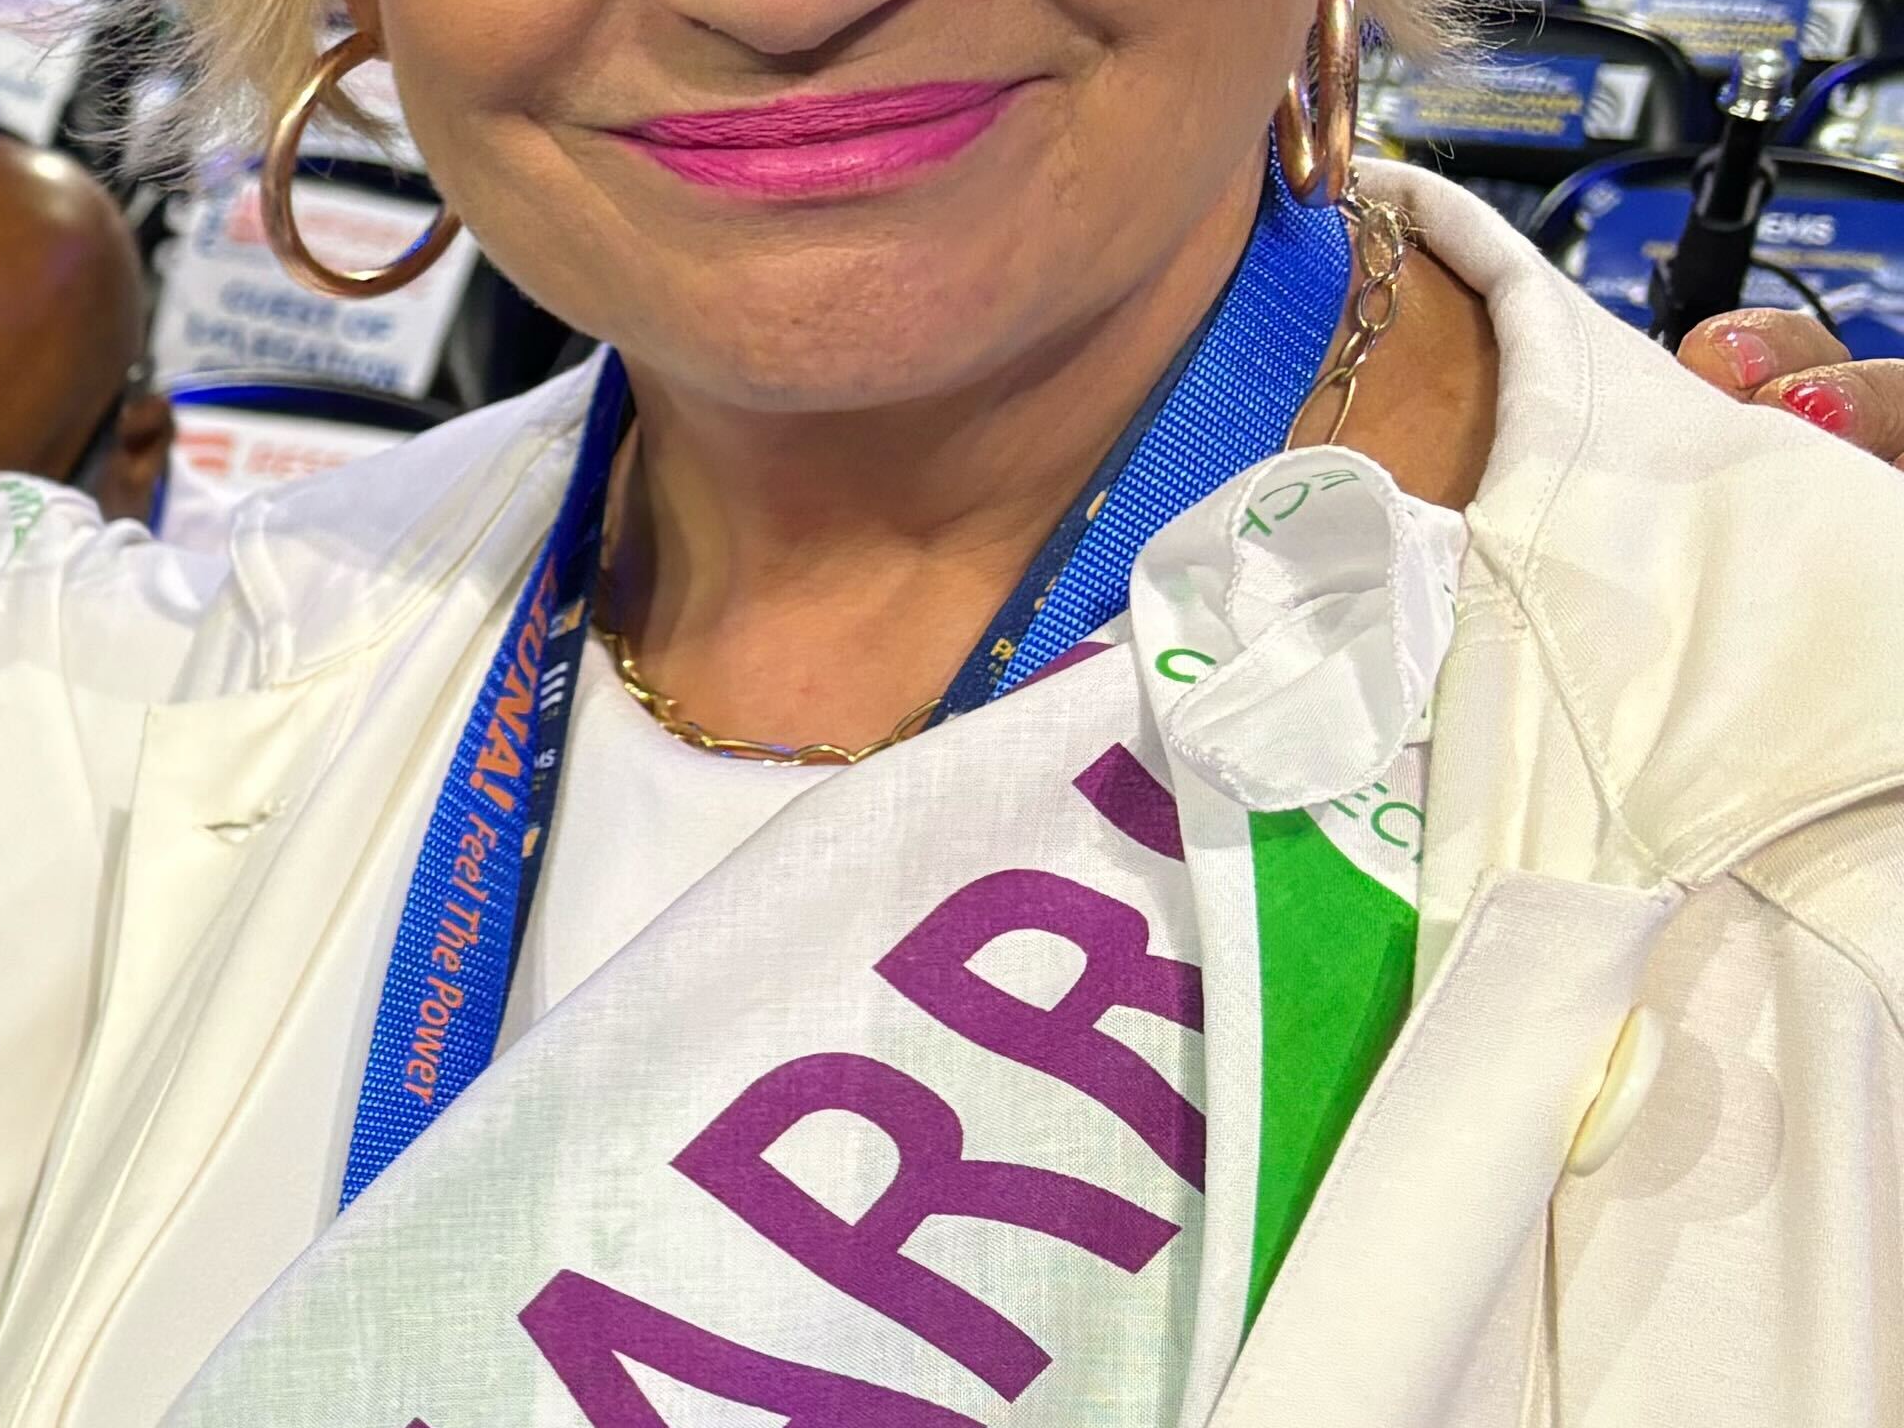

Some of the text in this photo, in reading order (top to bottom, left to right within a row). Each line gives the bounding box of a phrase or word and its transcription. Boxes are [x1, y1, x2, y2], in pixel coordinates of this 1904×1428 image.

[453, 813, 498, 902] Feel
[437, 902, 482, 973] The
[404, 974, 466, 1105] Power
